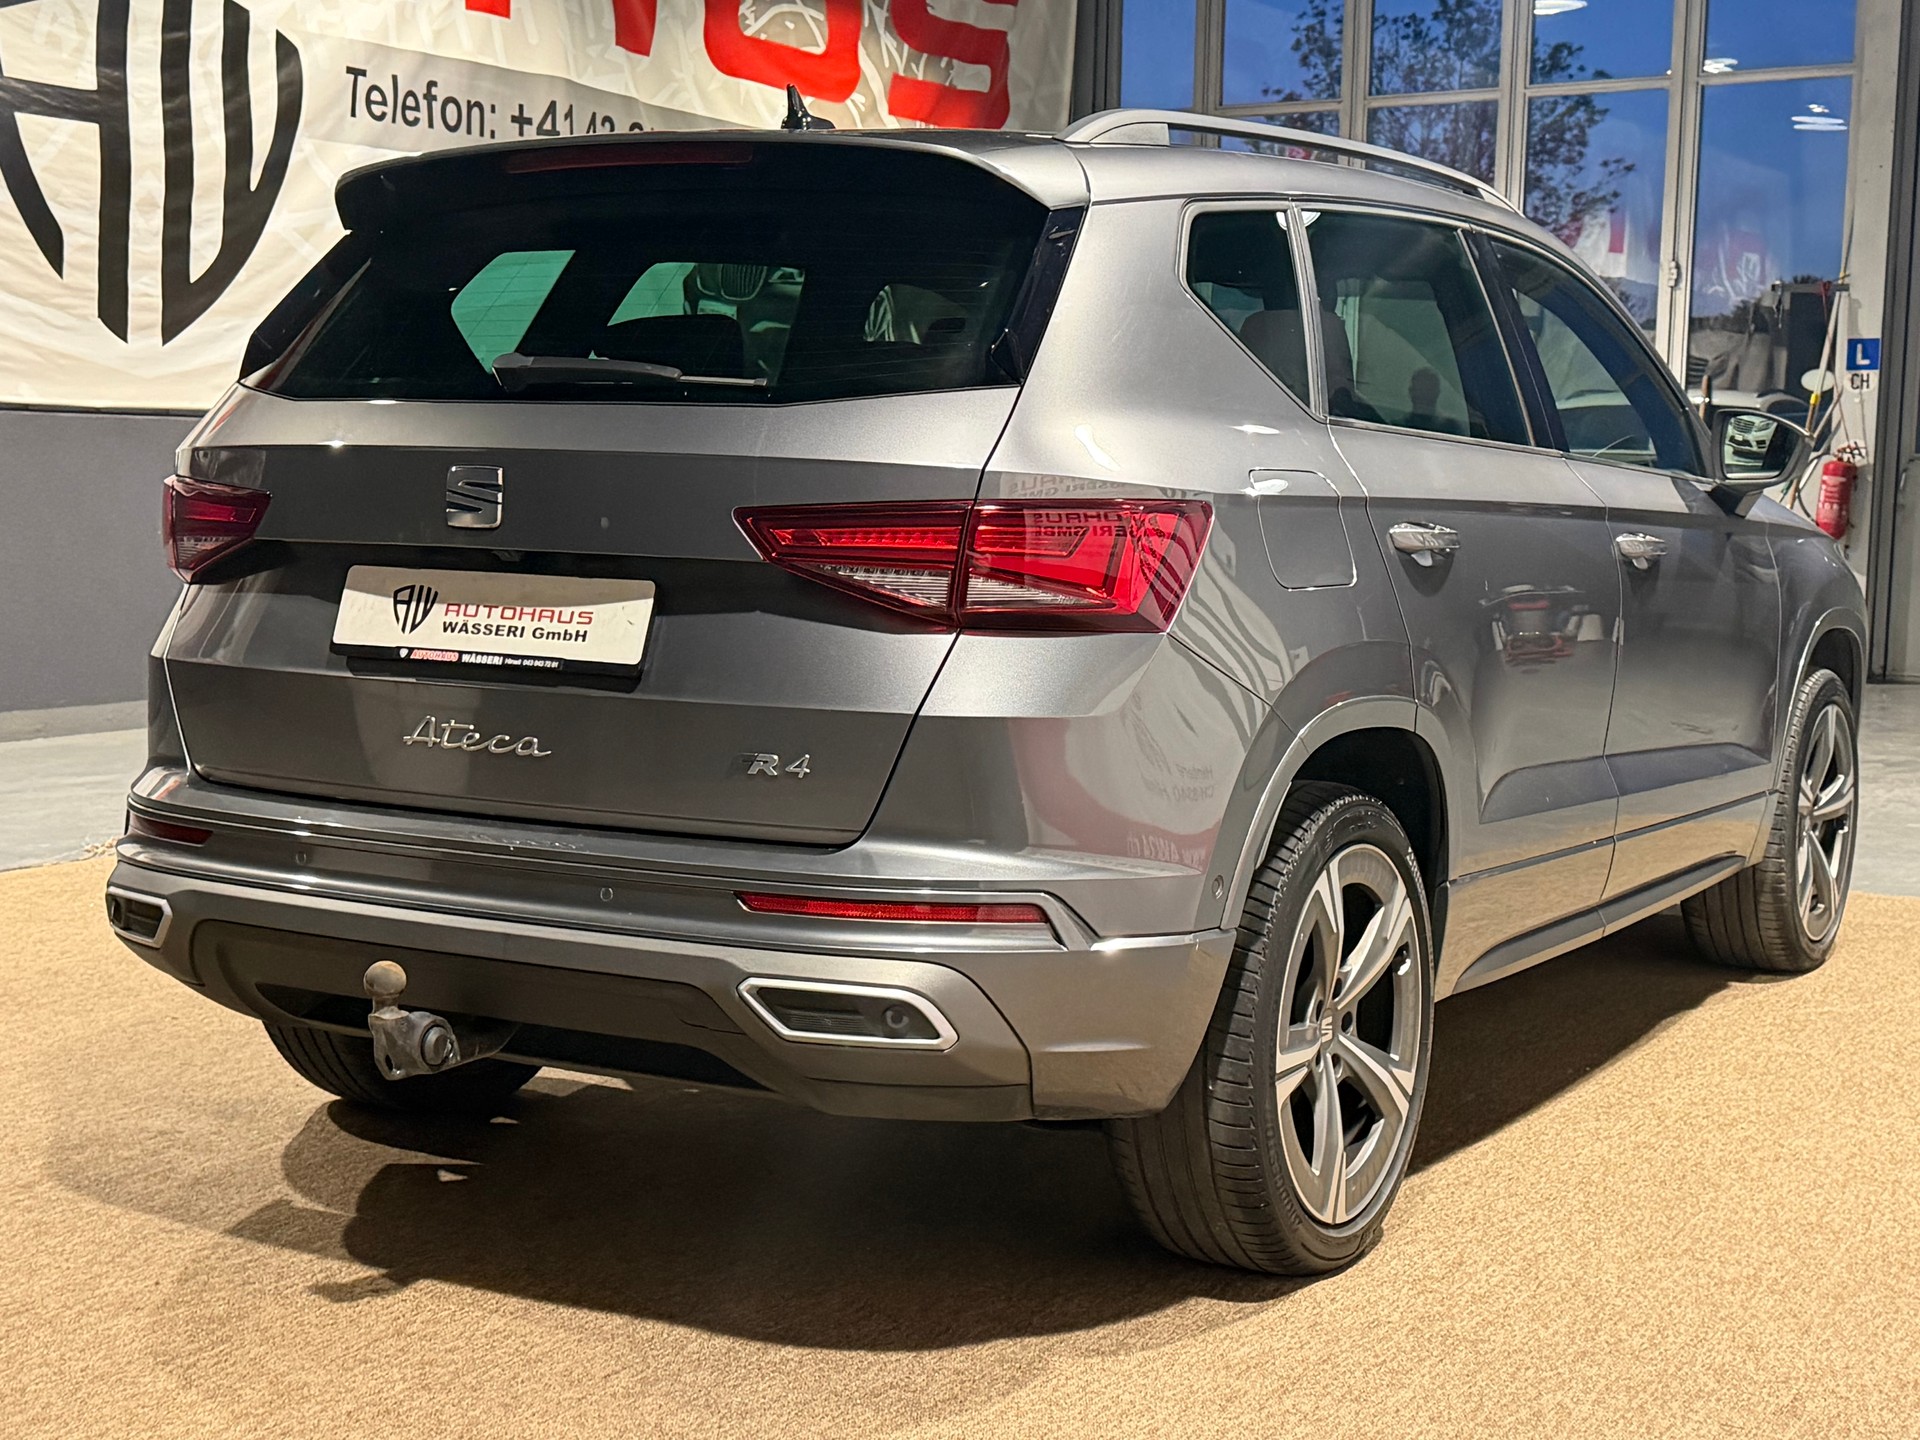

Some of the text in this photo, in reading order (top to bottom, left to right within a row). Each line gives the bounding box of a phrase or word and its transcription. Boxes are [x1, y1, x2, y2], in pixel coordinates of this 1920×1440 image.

[345, 65, 498, 140] Telefon:
[510, 100, 574, 137] +41
[1855, 343, 1871, 366] L
[1850, 373, 1870, 390] CH
[444, 603, 595, 625] AUTOHAUS
[442, 620, 588, 643] WÄSSERI GmbH
[410, 649, 460, 662] AUTOHAUS
[461, 653, 504, 666] WÄSSERI
[403, 715, 552, 758] Ateca
[785, 753, 811, 779] 4
